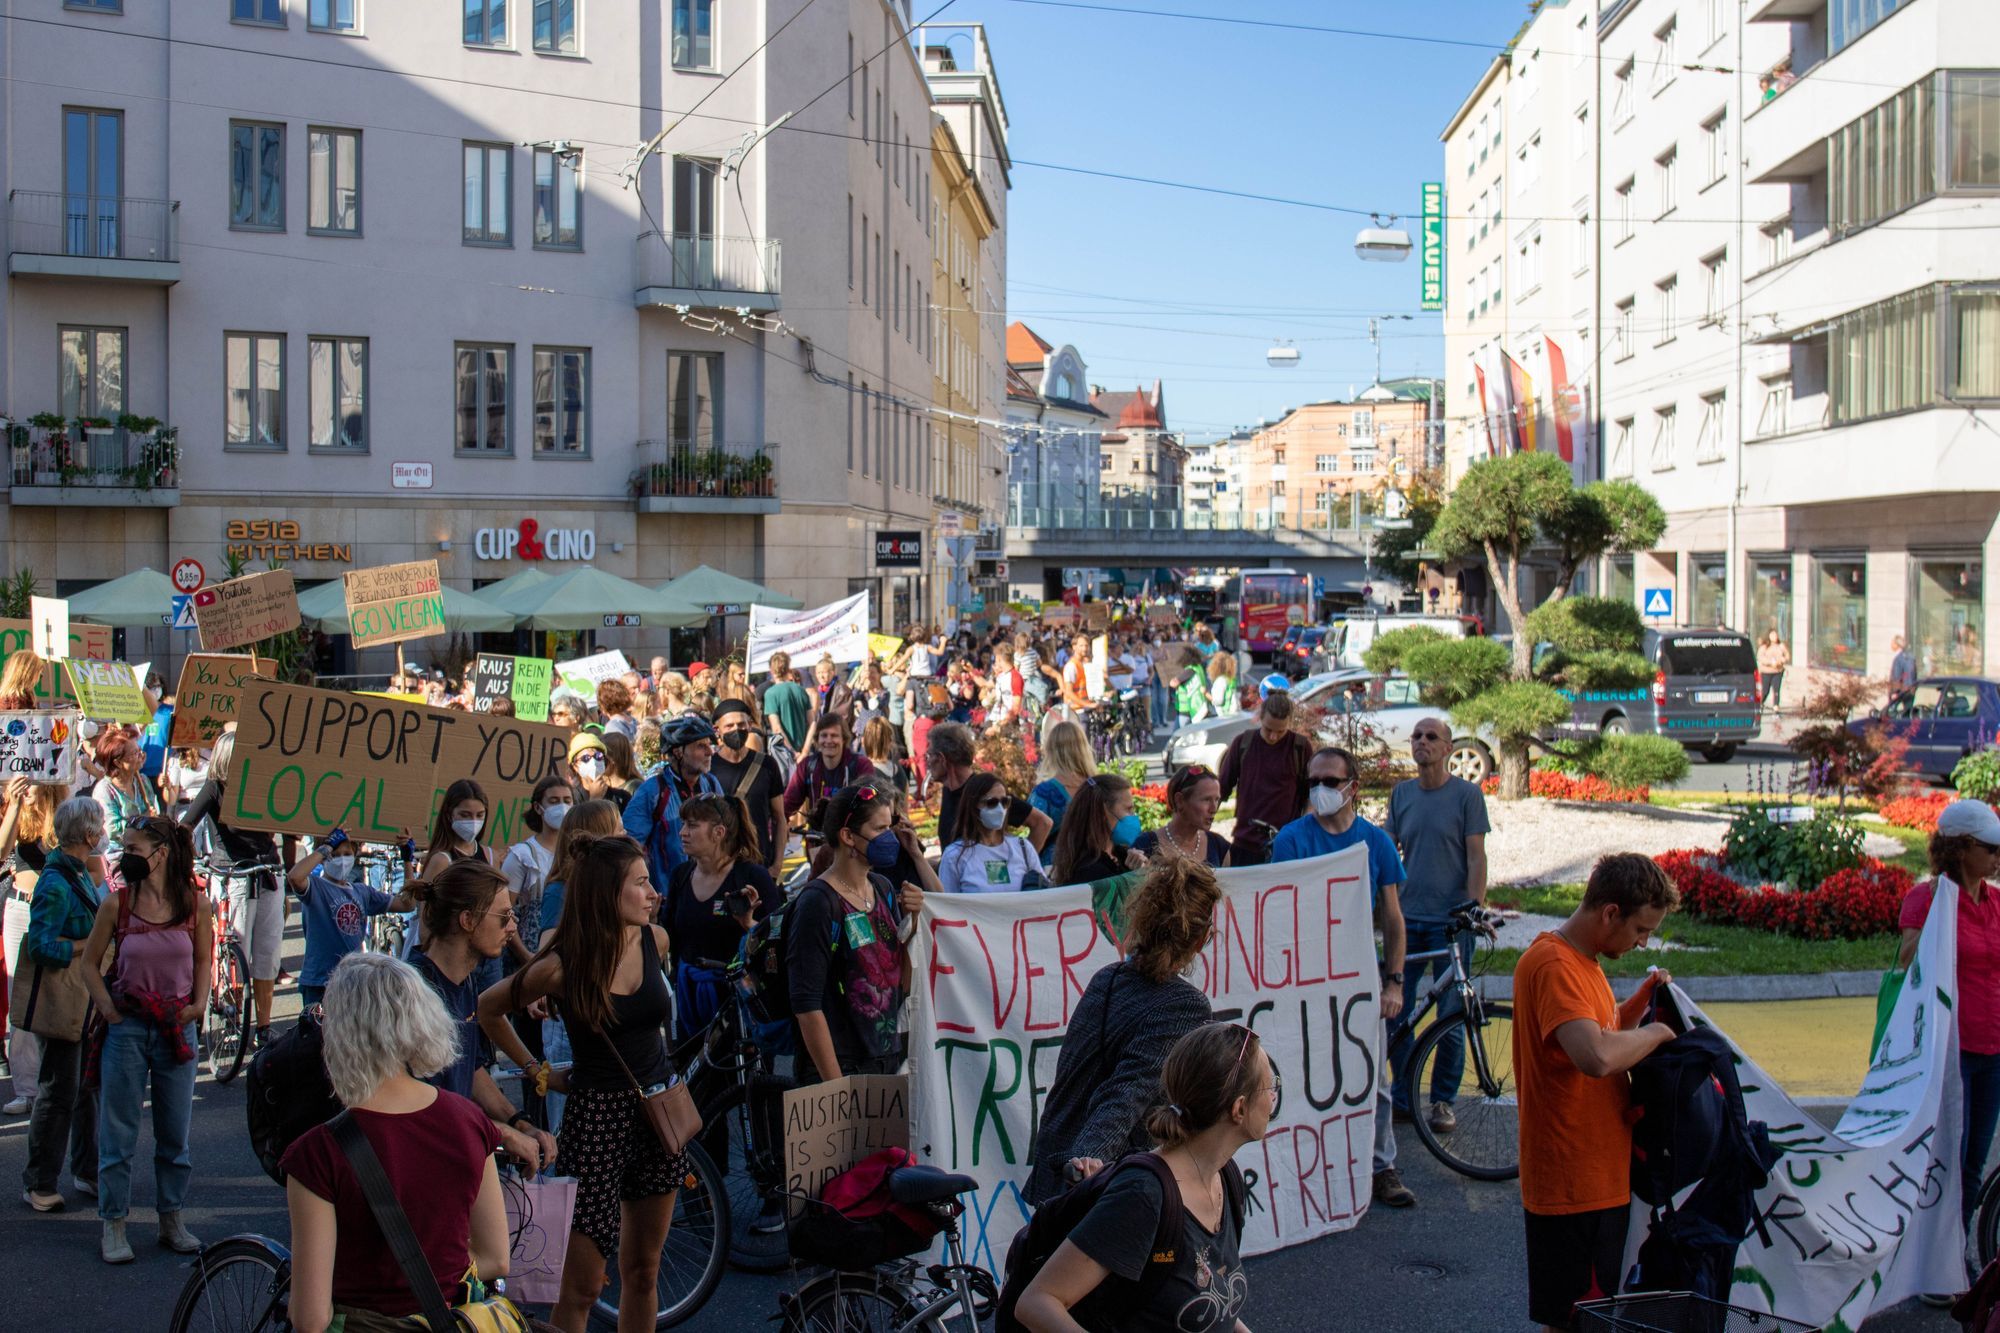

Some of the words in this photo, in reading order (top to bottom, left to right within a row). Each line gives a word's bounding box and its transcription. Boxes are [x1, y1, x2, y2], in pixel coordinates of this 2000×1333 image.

[1424, 184, 1440, 301] IMLAUER
[475, 518, 596, 561] CUP&CINO
[877, 538, 919, 554] CUP&CINO
[227, 543, 352, 562] KITCHEN
[216, 583, 252, 600] YouTube
[416, 579, 438, 594] DIR
[352, 608, 382, 637] GO
[384, 596, 446, 632] VEGAN
[604, 612, 640, 626] CUP&CINO
[195, 662, 219, 684] You
[478, 659, 512, 675] RAUS
[518, 663, 545, 678] REIN
[485, 680, 508, 694] AUS
[515, 683, 525, 696] IN
[526, 683, 541, 696] DIE
[182, 691, 205, 708] UP
[210, 693, 235, 714] FOR
[516, 702, 547, 716] UKUNFT
[258, 690, 456, 764] SUPPORT
[471, 723, 569, 786] YOUR
[10, 757, 45, 772] COBAIN
[236, 757, 399, 833] LOCAL
[935, 1036, 1065, 1170] TRE
[1300, 992, 1375, 1111] US
[787, 1088, 904, 1136] AUSTRALIA
[790, 1141, 811, 1171] IS
[824, 1126, 893, 1157] STILL
[1262, 1109, 1373, 1238] FREE
